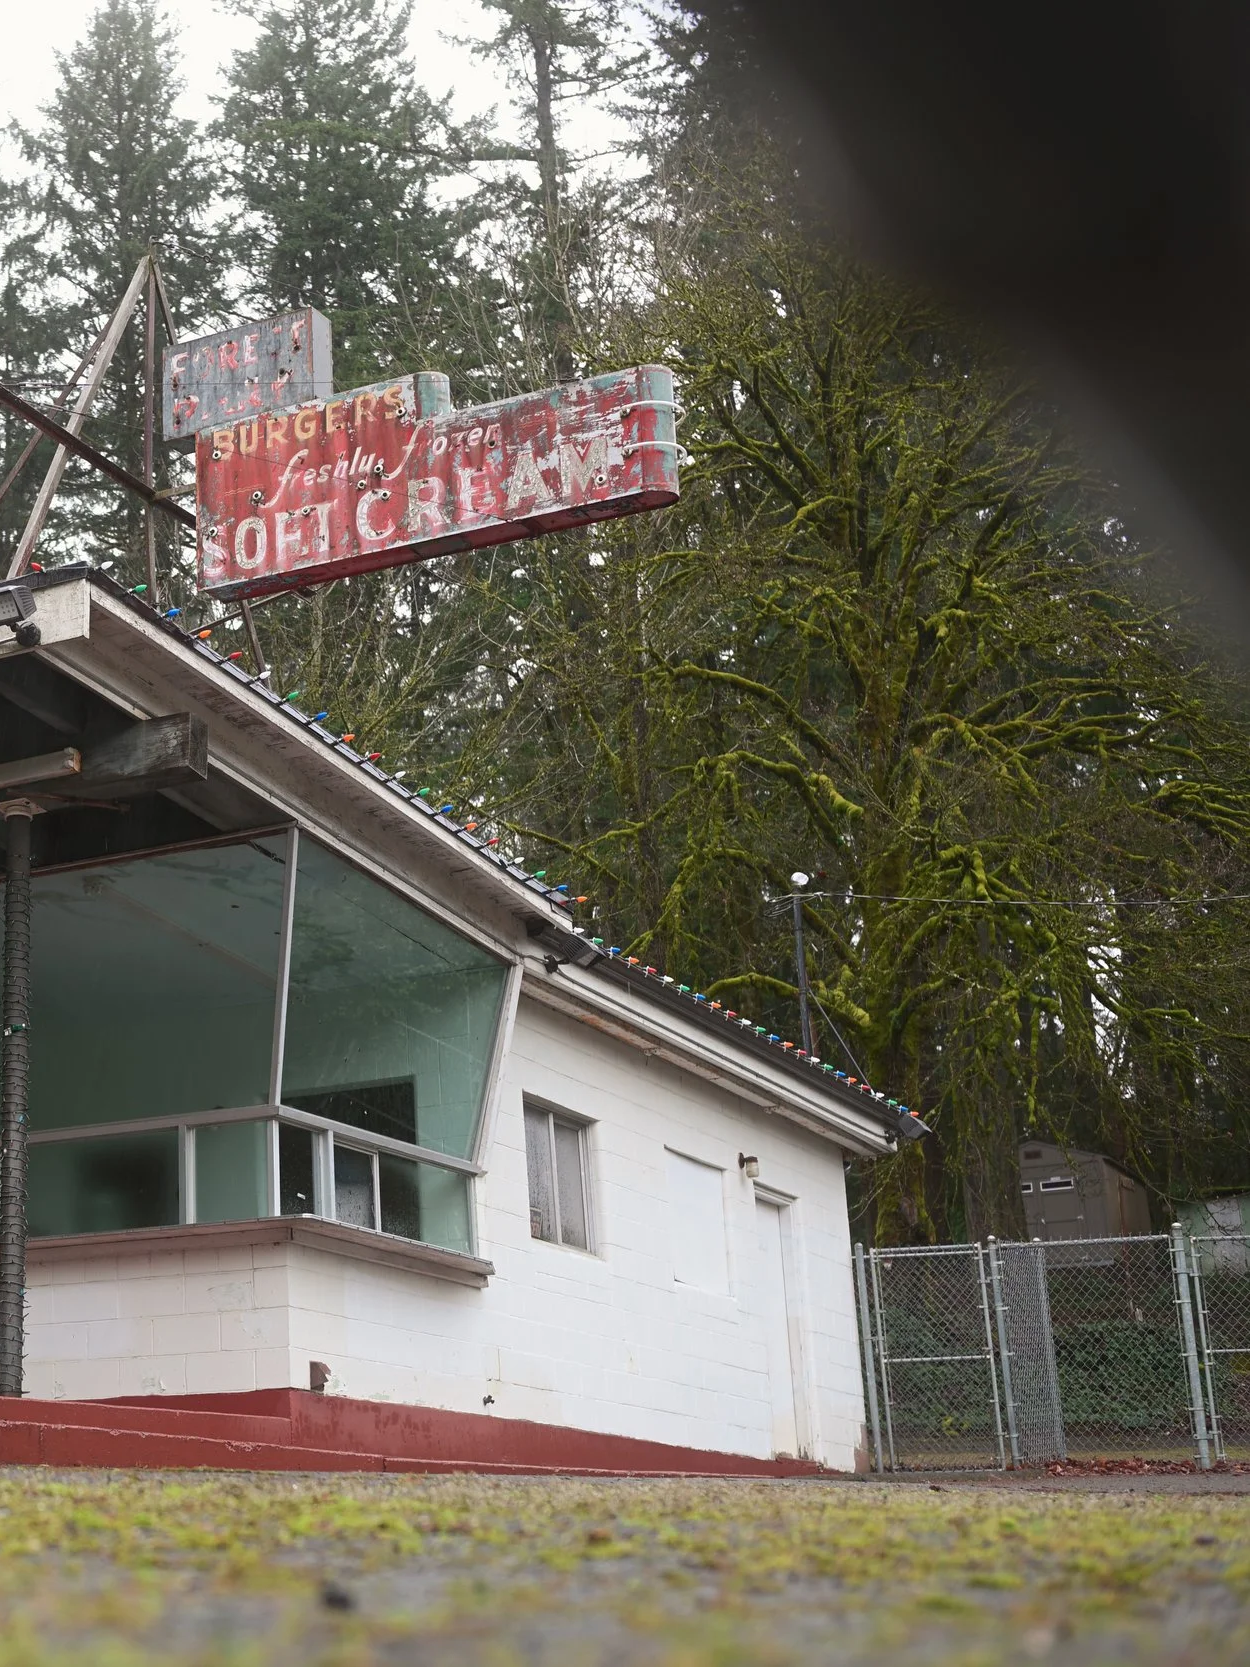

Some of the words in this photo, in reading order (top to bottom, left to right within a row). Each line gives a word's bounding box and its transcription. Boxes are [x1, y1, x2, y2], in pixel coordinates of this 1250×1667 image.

[170, 318, 306, 392] FORET
[212, 384, 405, 461] BURGERS
[201, 497, 340, 579] SOFT
[355, 436, 618, 541] CREAM
